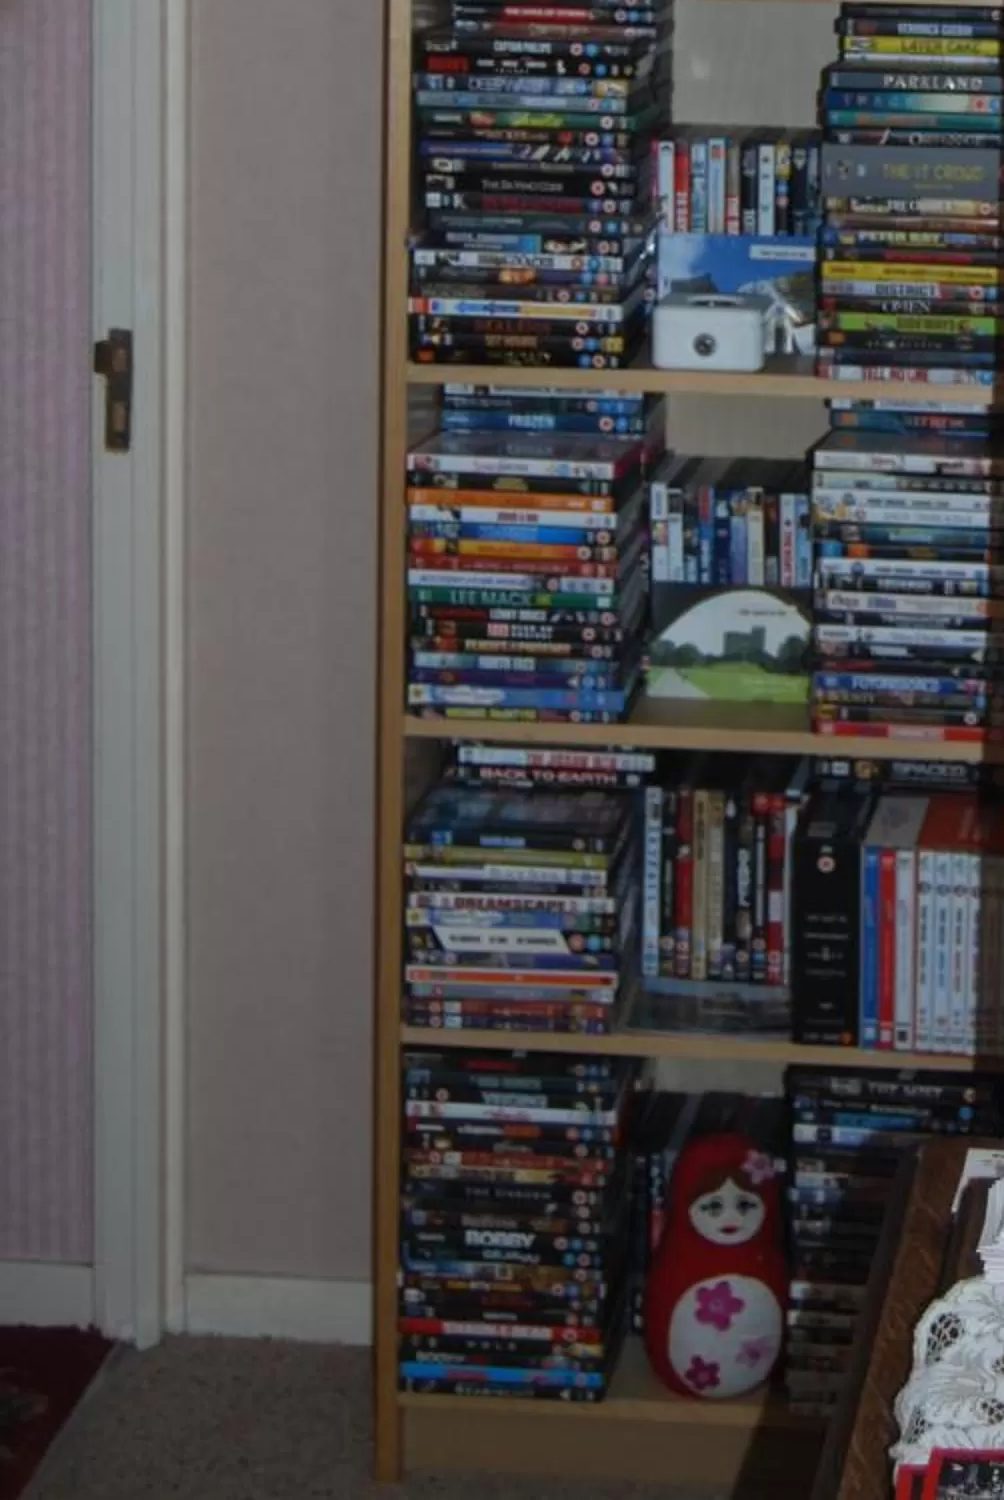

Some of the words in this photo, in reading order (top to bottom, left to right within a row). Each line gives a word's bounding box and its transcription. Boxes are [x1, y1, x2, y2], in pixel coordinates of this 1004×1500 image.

[883, 75, 983, 90] PARKLAND
[451, 591, 478, 604] LEE
[530, 770, 554, 781] TO
